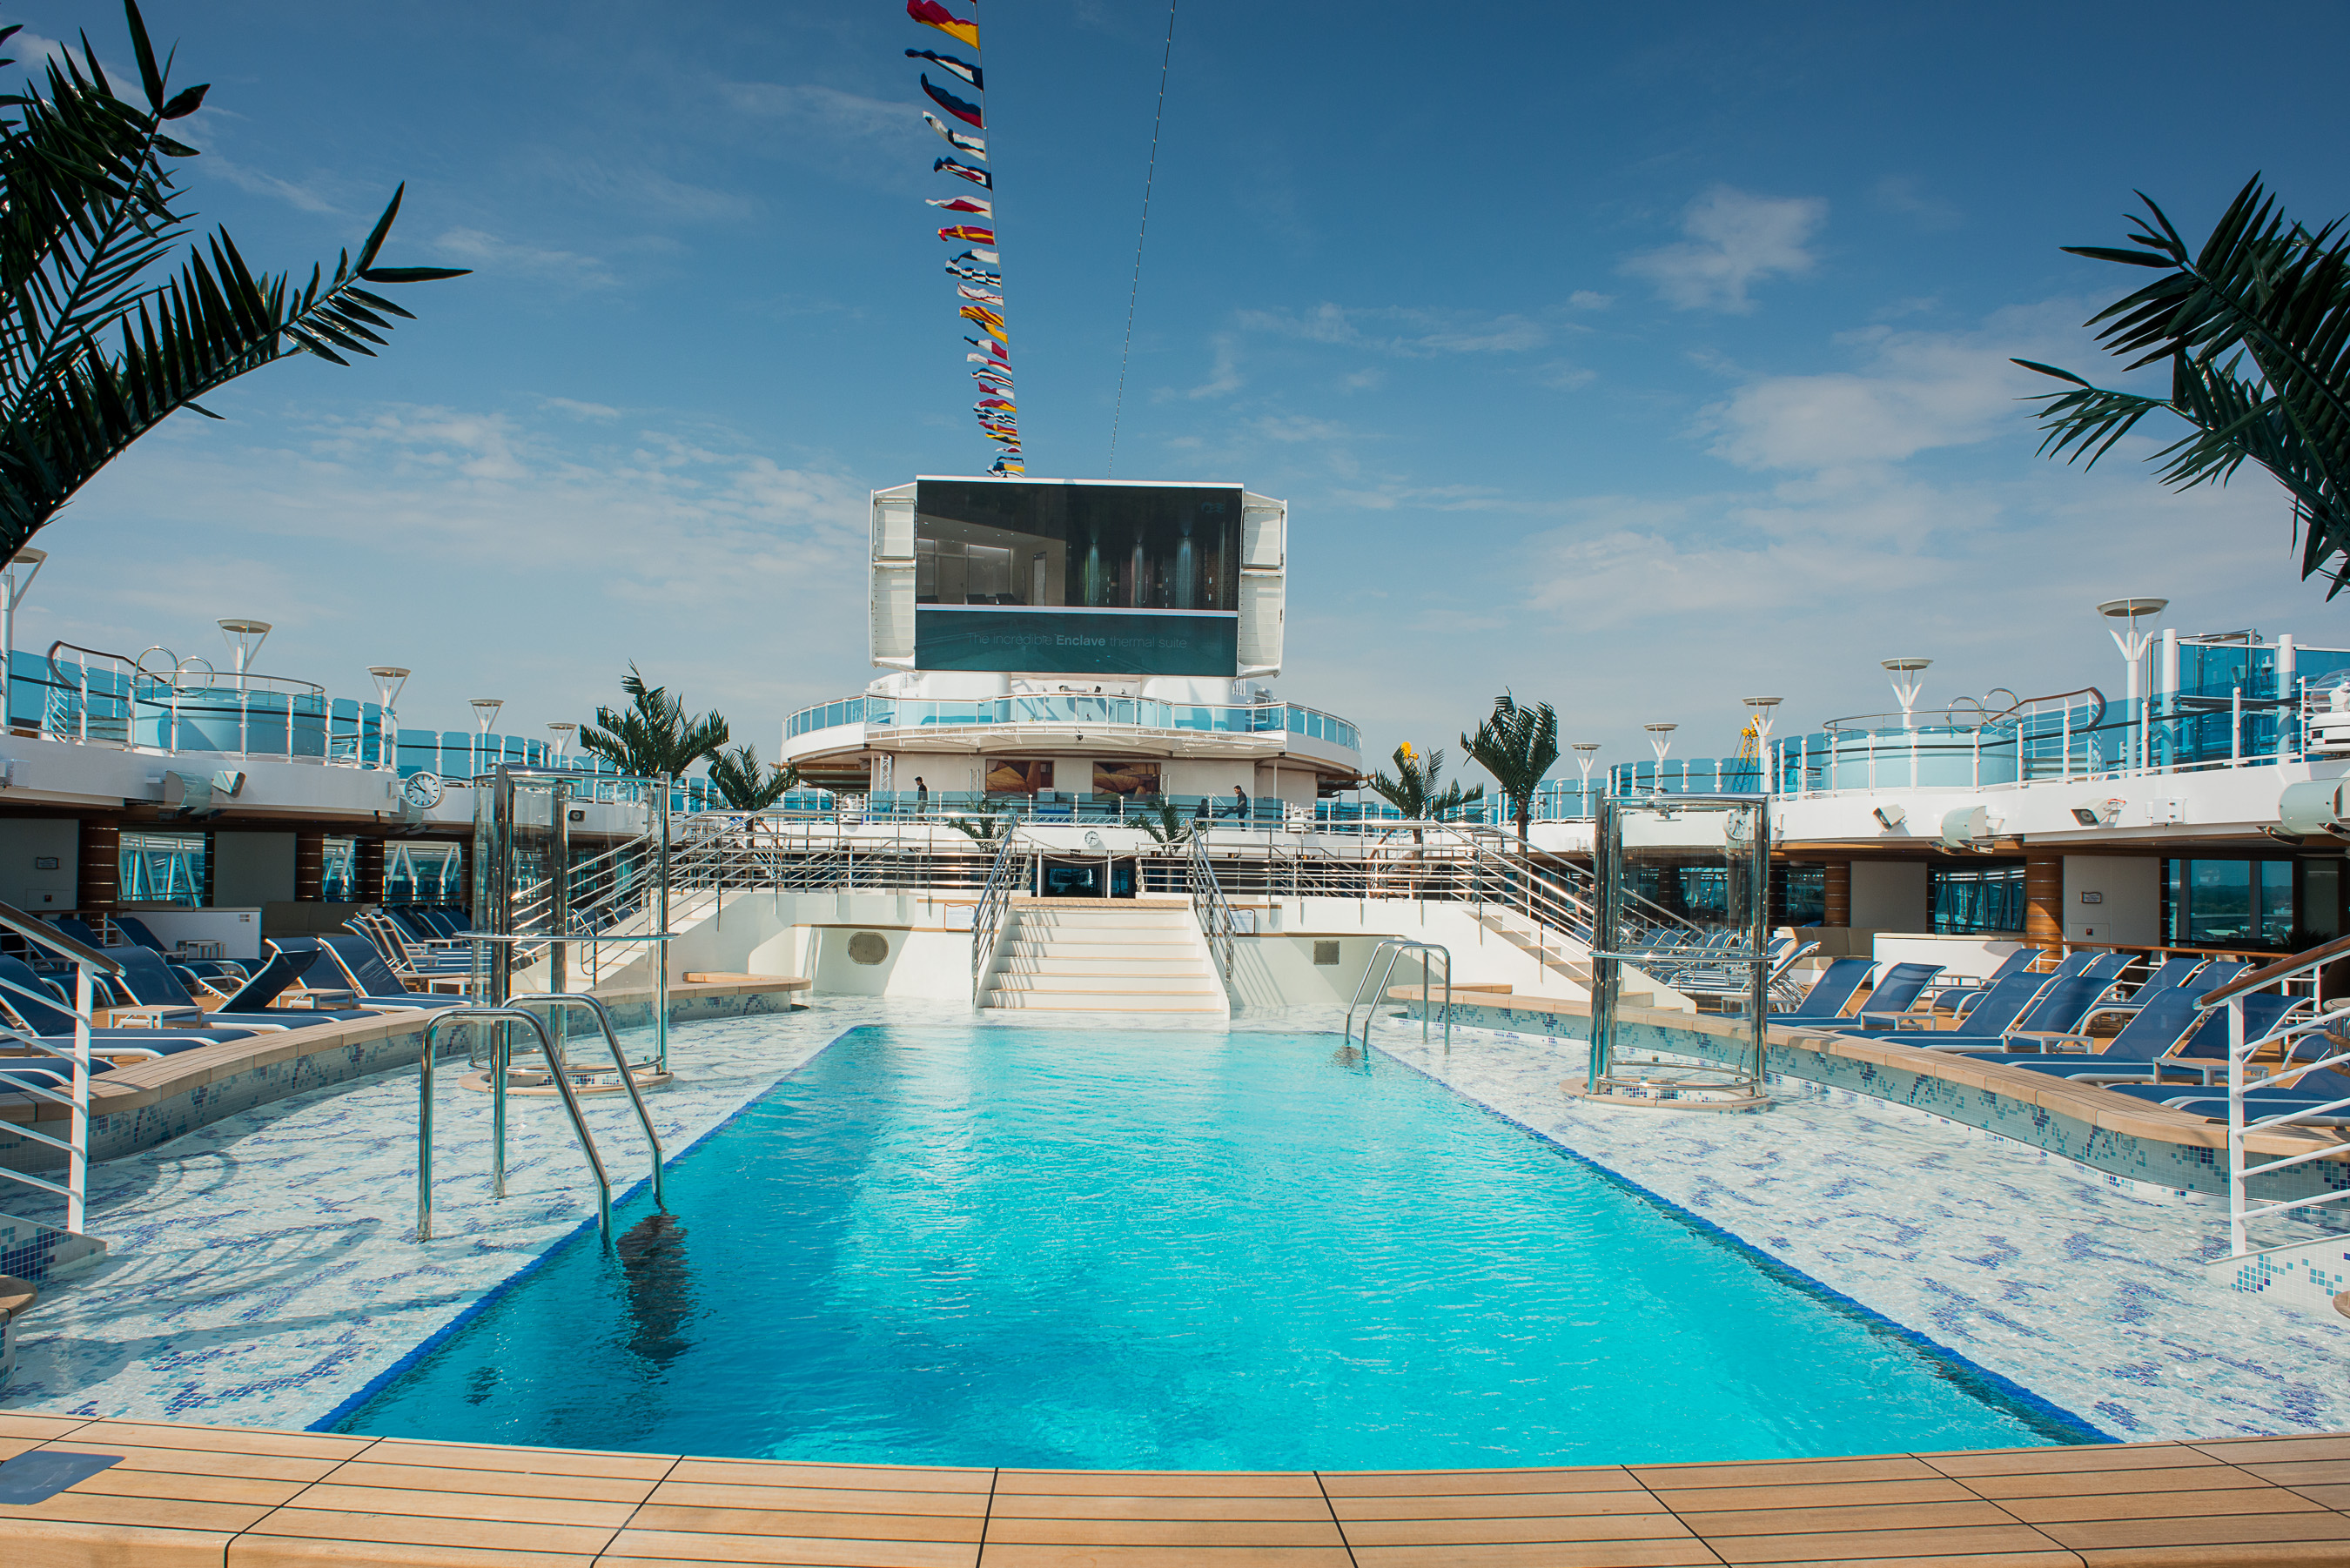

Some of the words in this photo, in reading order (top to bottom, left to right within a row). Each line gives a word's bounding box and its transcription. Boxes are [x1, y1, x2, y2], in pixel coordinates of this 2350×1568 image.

[967, 633, 990, 645] The
[993, 633, 1052, 646] incredible
[1056, 634, 1106, 647] Enclave
[1110, 636, 1155, 647] thermal
[1158, 637, 1187, 648] suite
